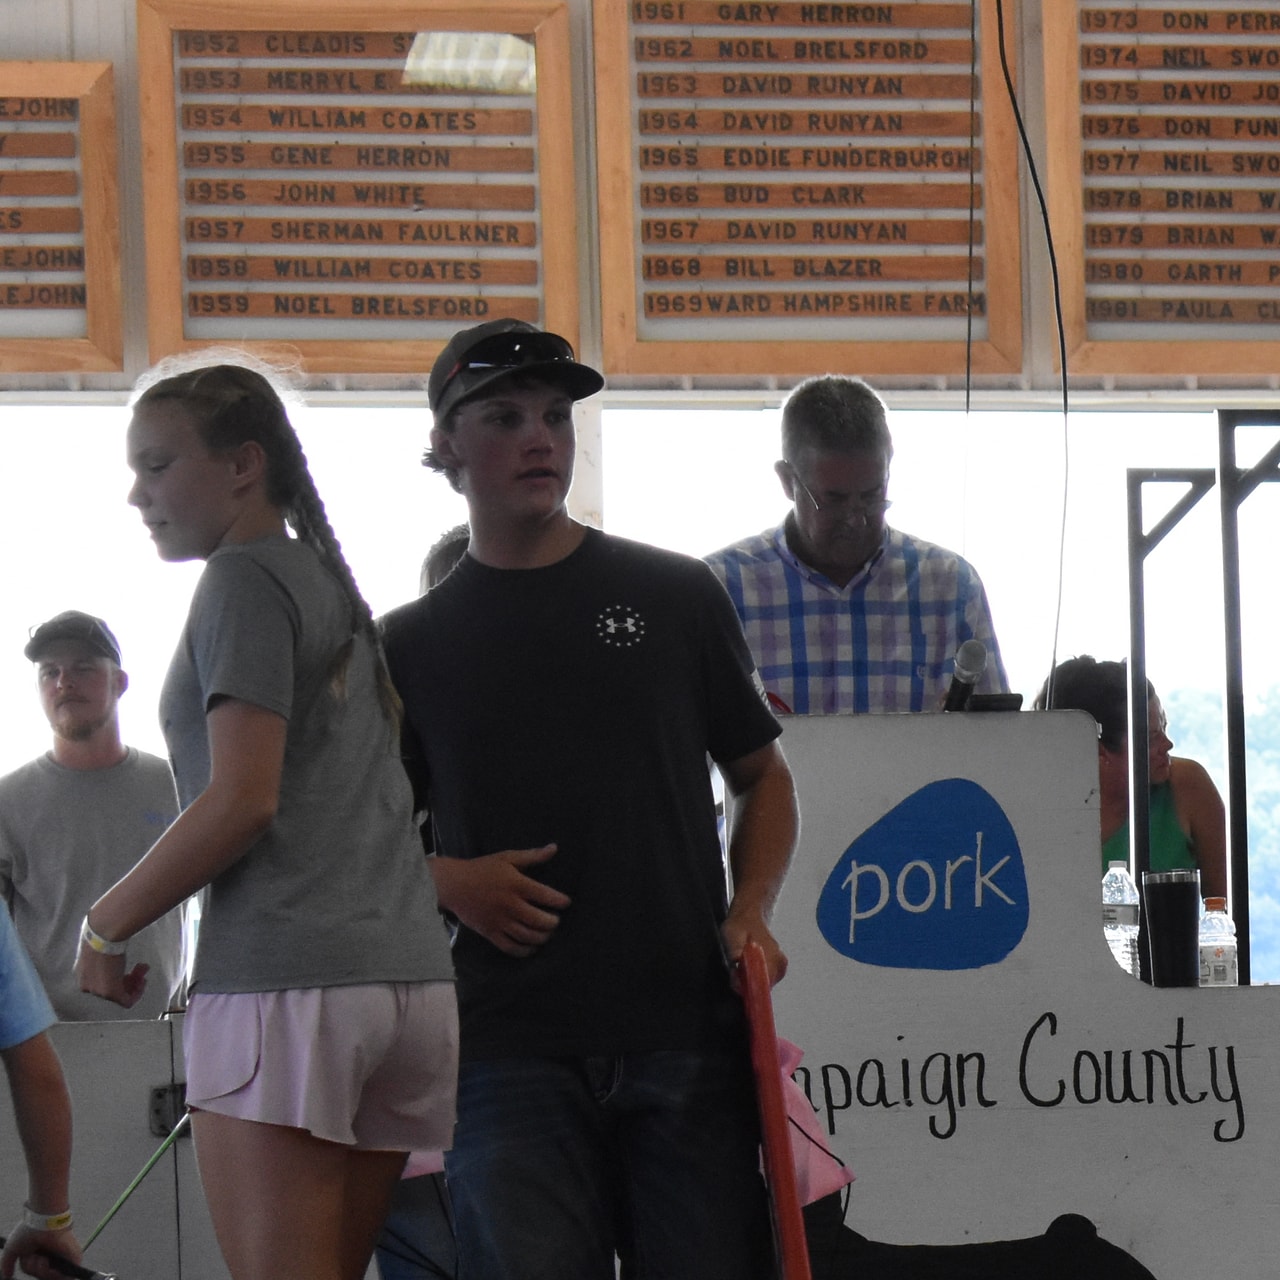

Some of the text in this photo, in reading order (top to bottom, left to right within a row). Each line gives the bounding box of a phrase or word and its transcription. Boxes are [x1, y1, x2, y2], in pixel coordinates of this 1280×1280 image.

[636, 2, 892, 22] 1961 GARY HERRON
[1086, 11, 1137, 29] 1973
[1163, 12, 1208, 30] DON
[639, 40, 928, 59] 1962 NOEL BRELSFORD
[1086, 48, 1138, 64] 1974
[1163, 48, 1211, 66] NEIL
[641, 76, 903, 94] 1963 DAVID RUNYAN
[1086, 84, 1138, 99] 1975
[1163, 84, 1231, 100] DAVID
[188, 109, 477, 130] 1954 WILLIAM COATES
[642, 111, 903, 131] 1964 DAVID RUNYAN
[1088, 118, 1140, 134] 1976
[1165, 119, 1210, 136] DON
[189, 146, 449, 167] 1955 GENE HERRON
[1088, 155, 1139, 171] 1977
[1164, 156, 1212, 172] NEIL
[190, 183, 426, 204] 1956 JOHN WHITE
[643, 185, 865, 204] 1966 BUD CLARK
[190, 221, 519, 242] 1957 SHERMAN FAULKNER
[646, 222, 906, 240] 1967 DAVID RUNYAN
[1091, 227, 1143, 245] 1979
[1168, 228, 1234, 244] BRIAN
[191, 258, 481, 279] 1958 WILLIAM COATES
[646, 258, 882, 277] 1968 BILL BLAZER
[1089, 264, 1142, 280] 1980
[1168, 264, 1241, 281] GARTH
[192, 295, 489, 316] 1959 NOEL BRELSFORD
[842, 832, 1016, 943] pork
[1019, 1012, 1246, 1142] County
